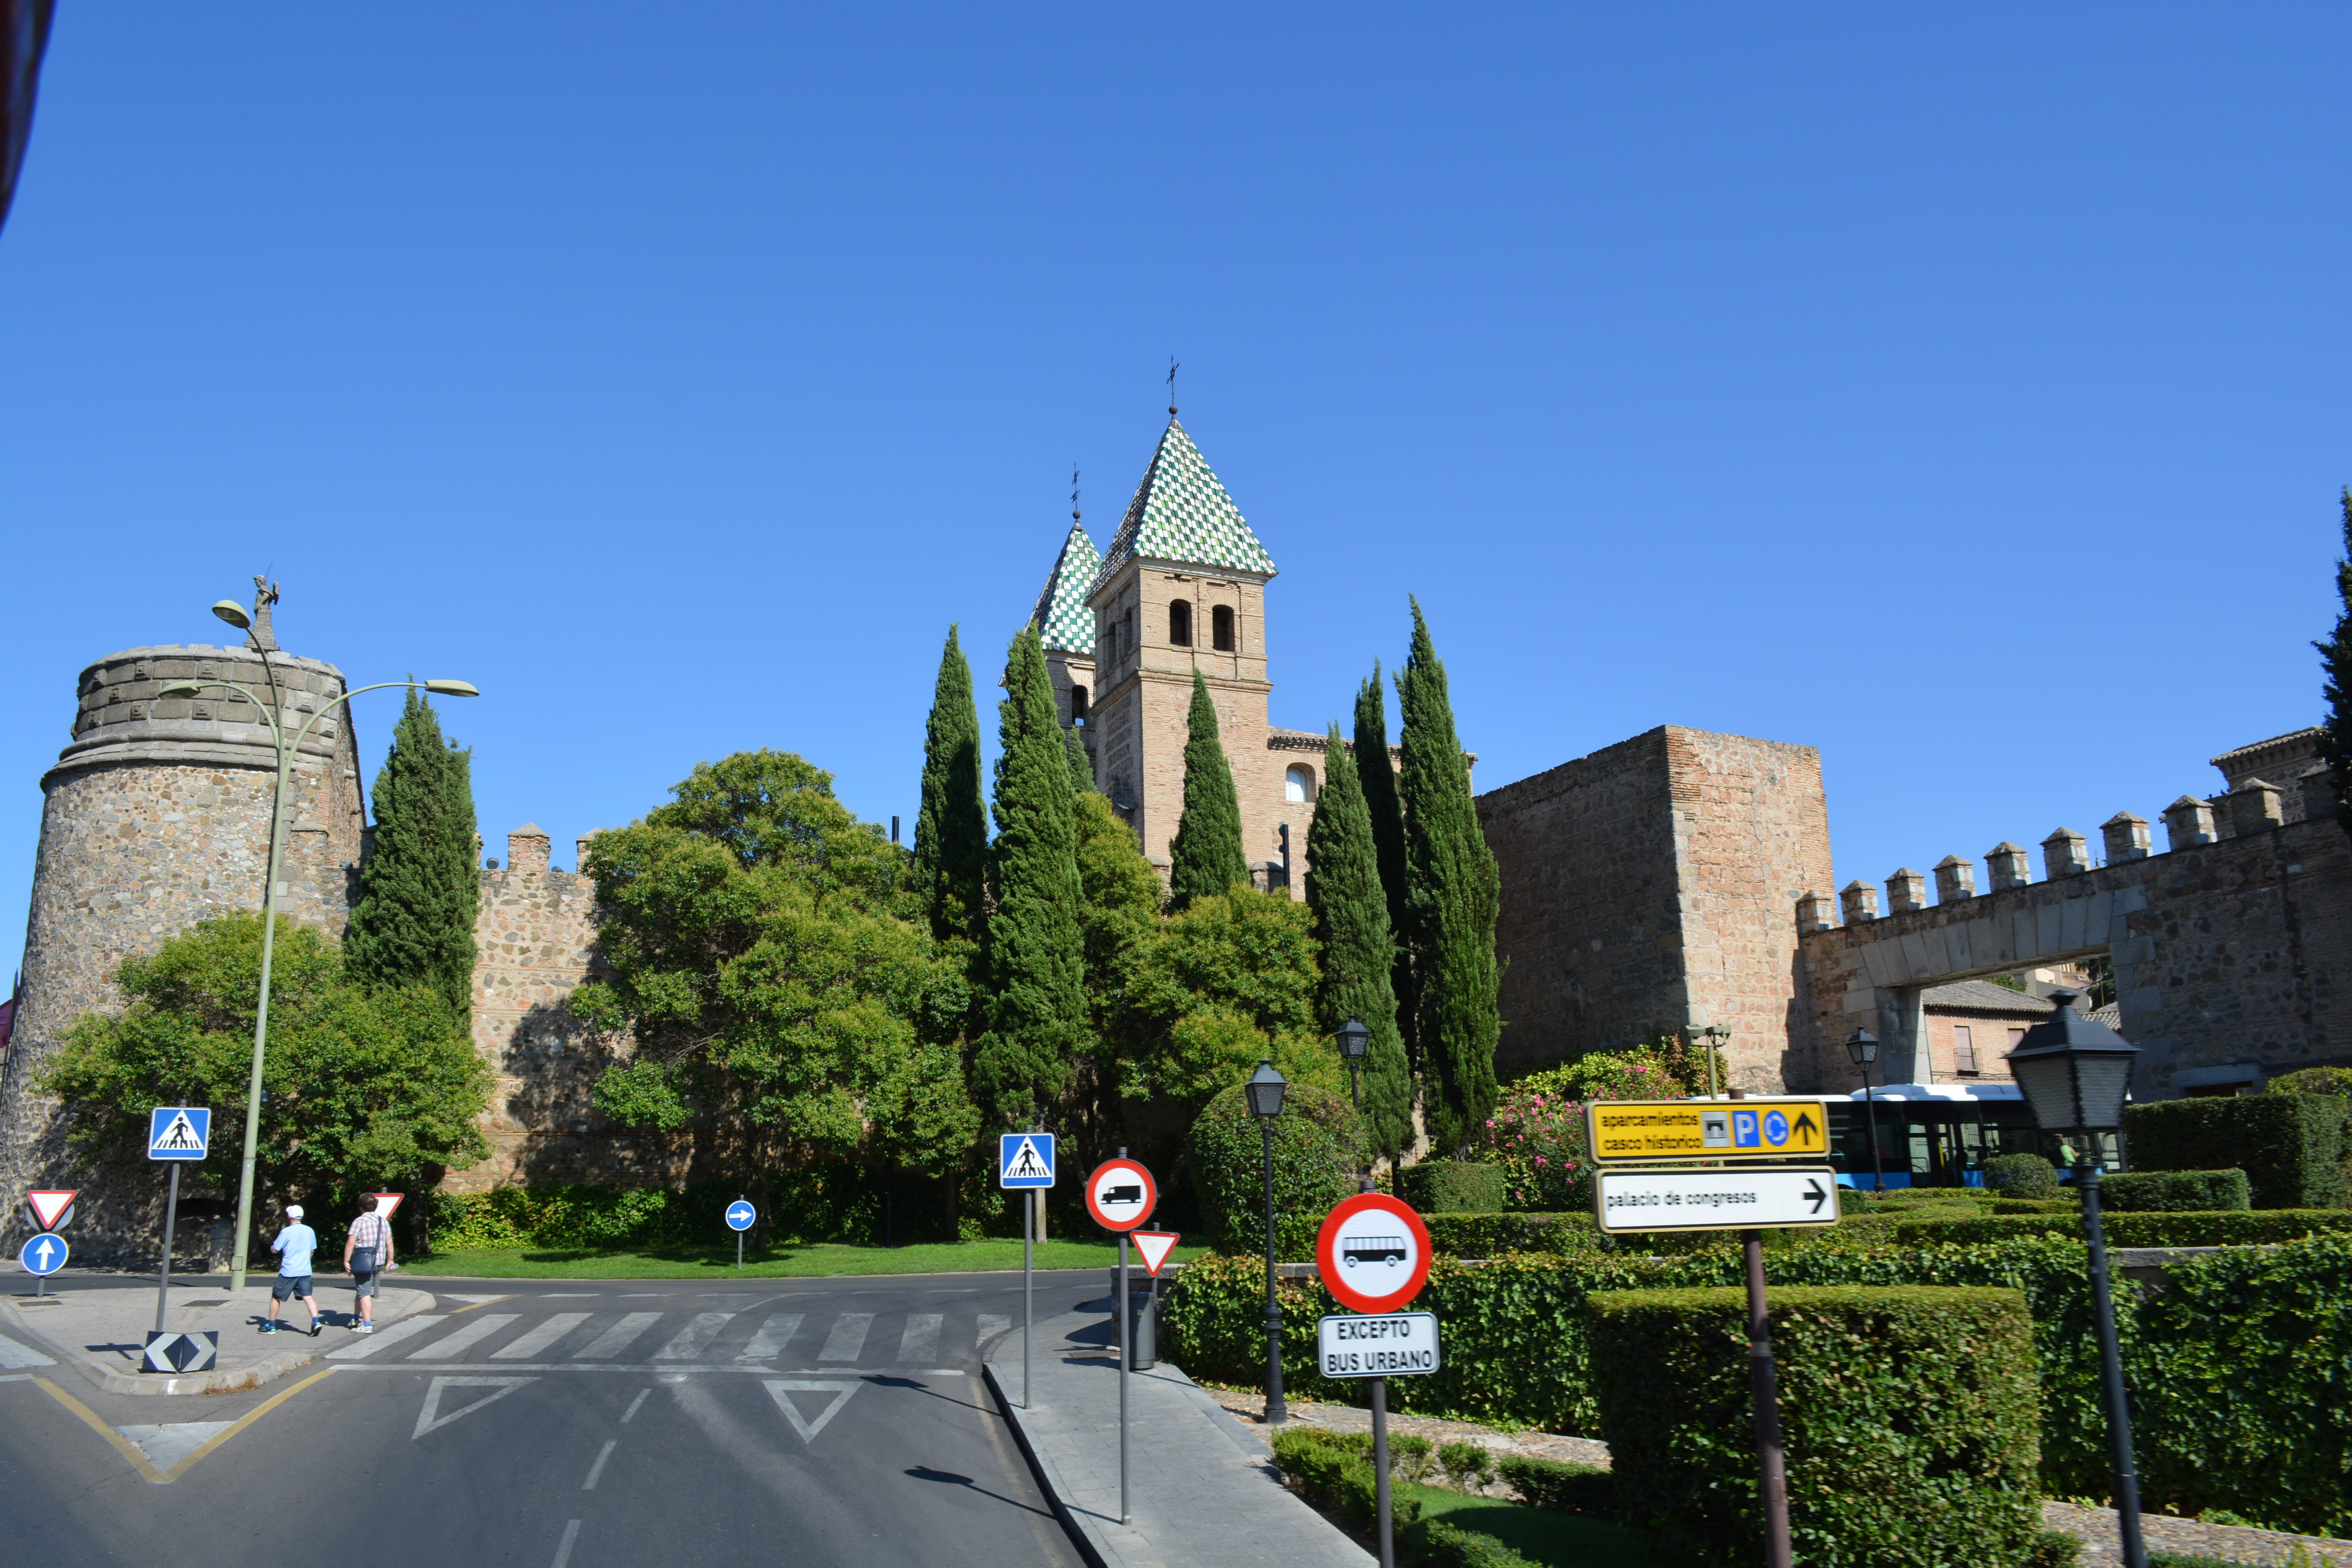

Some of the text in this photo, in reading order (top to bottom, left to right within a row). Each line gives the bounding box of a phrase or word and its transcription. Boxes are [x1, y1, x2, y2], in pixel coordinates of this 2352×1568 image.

[1601, 1111, 1698, 1131] aparcamientos
[1736, 1114, 1756, 1144] P
[1604, 1139, 1642, 1150] casco
[1607, 1191, 1757, 1211] palacio de congresos
[1338, 1320, 1410, 1340] EXCEPTO
[1327, 1350, 1432, 1372] BUS URBANO
